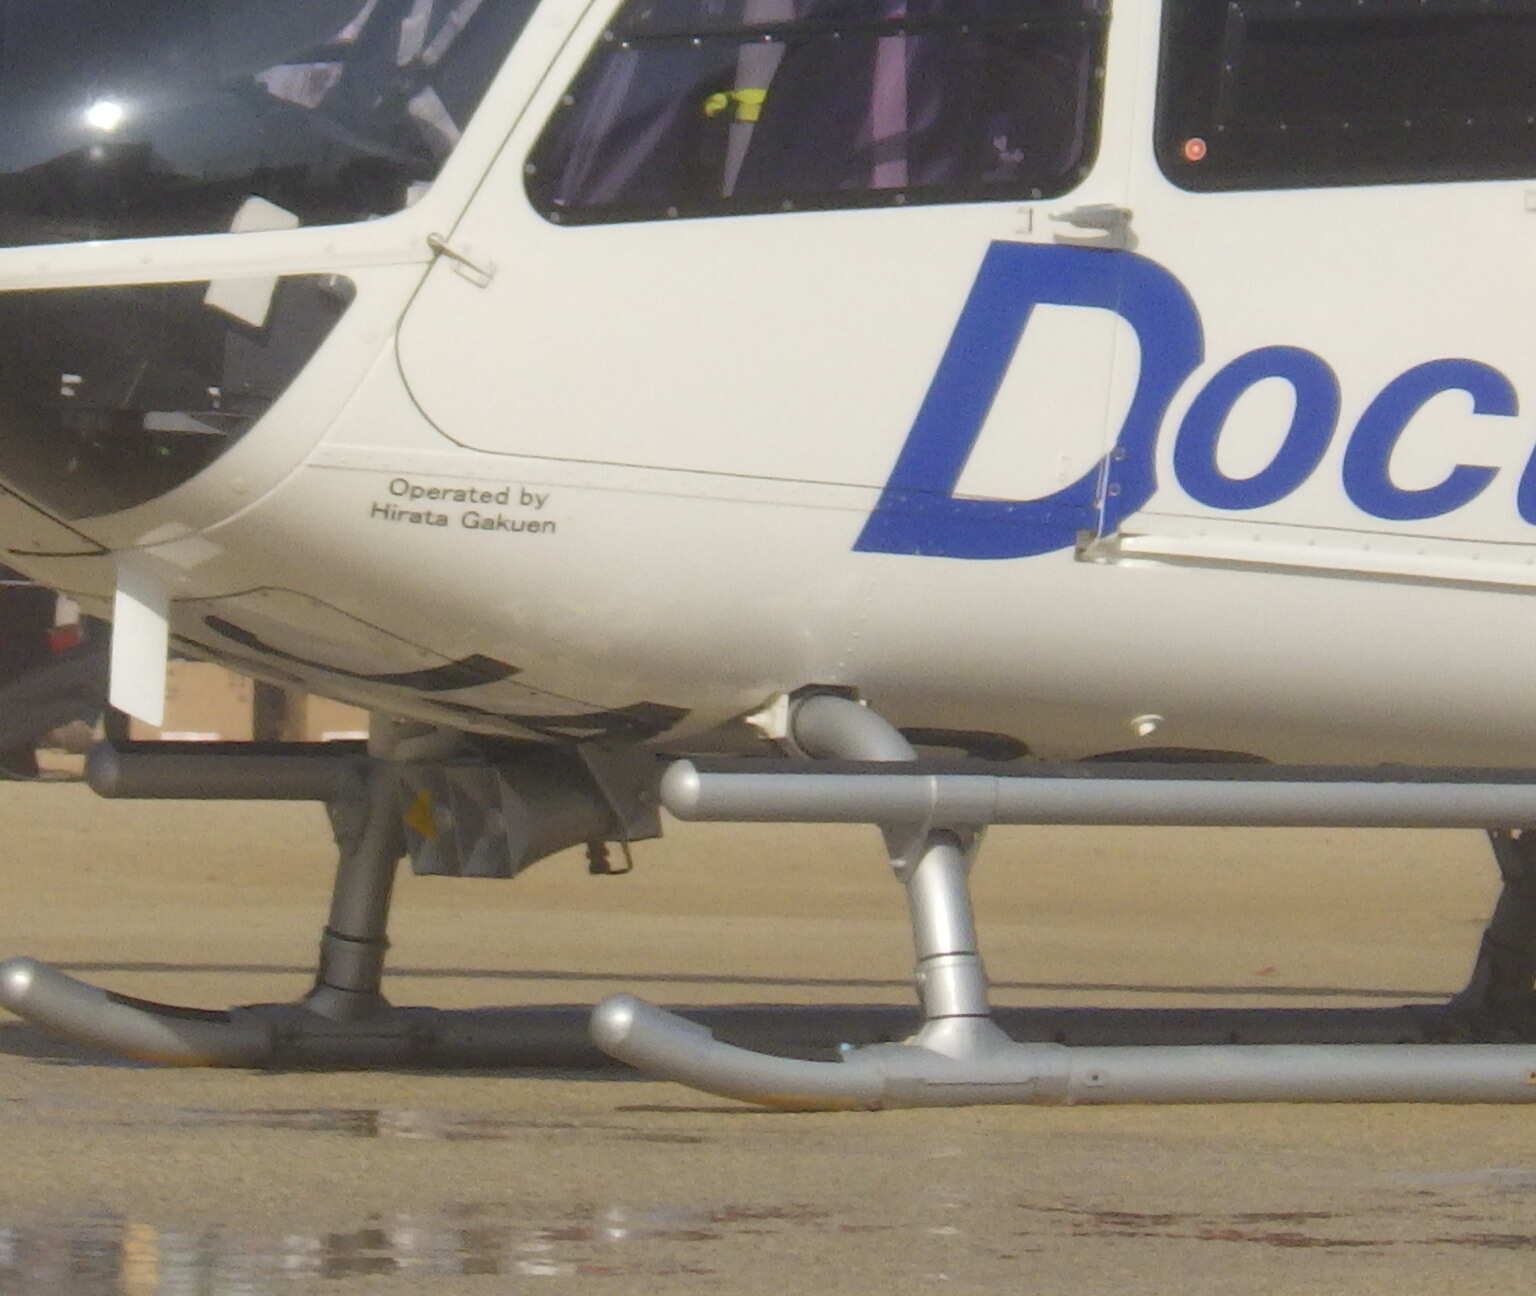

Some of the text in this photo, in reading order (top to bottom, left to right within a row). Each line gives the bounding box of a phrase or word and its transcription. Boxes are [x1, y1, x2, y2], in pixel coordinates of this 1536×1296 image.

[388, 477, 550, 510] Operated by
[369, 501, 557, 535] Hirata Gakuen
